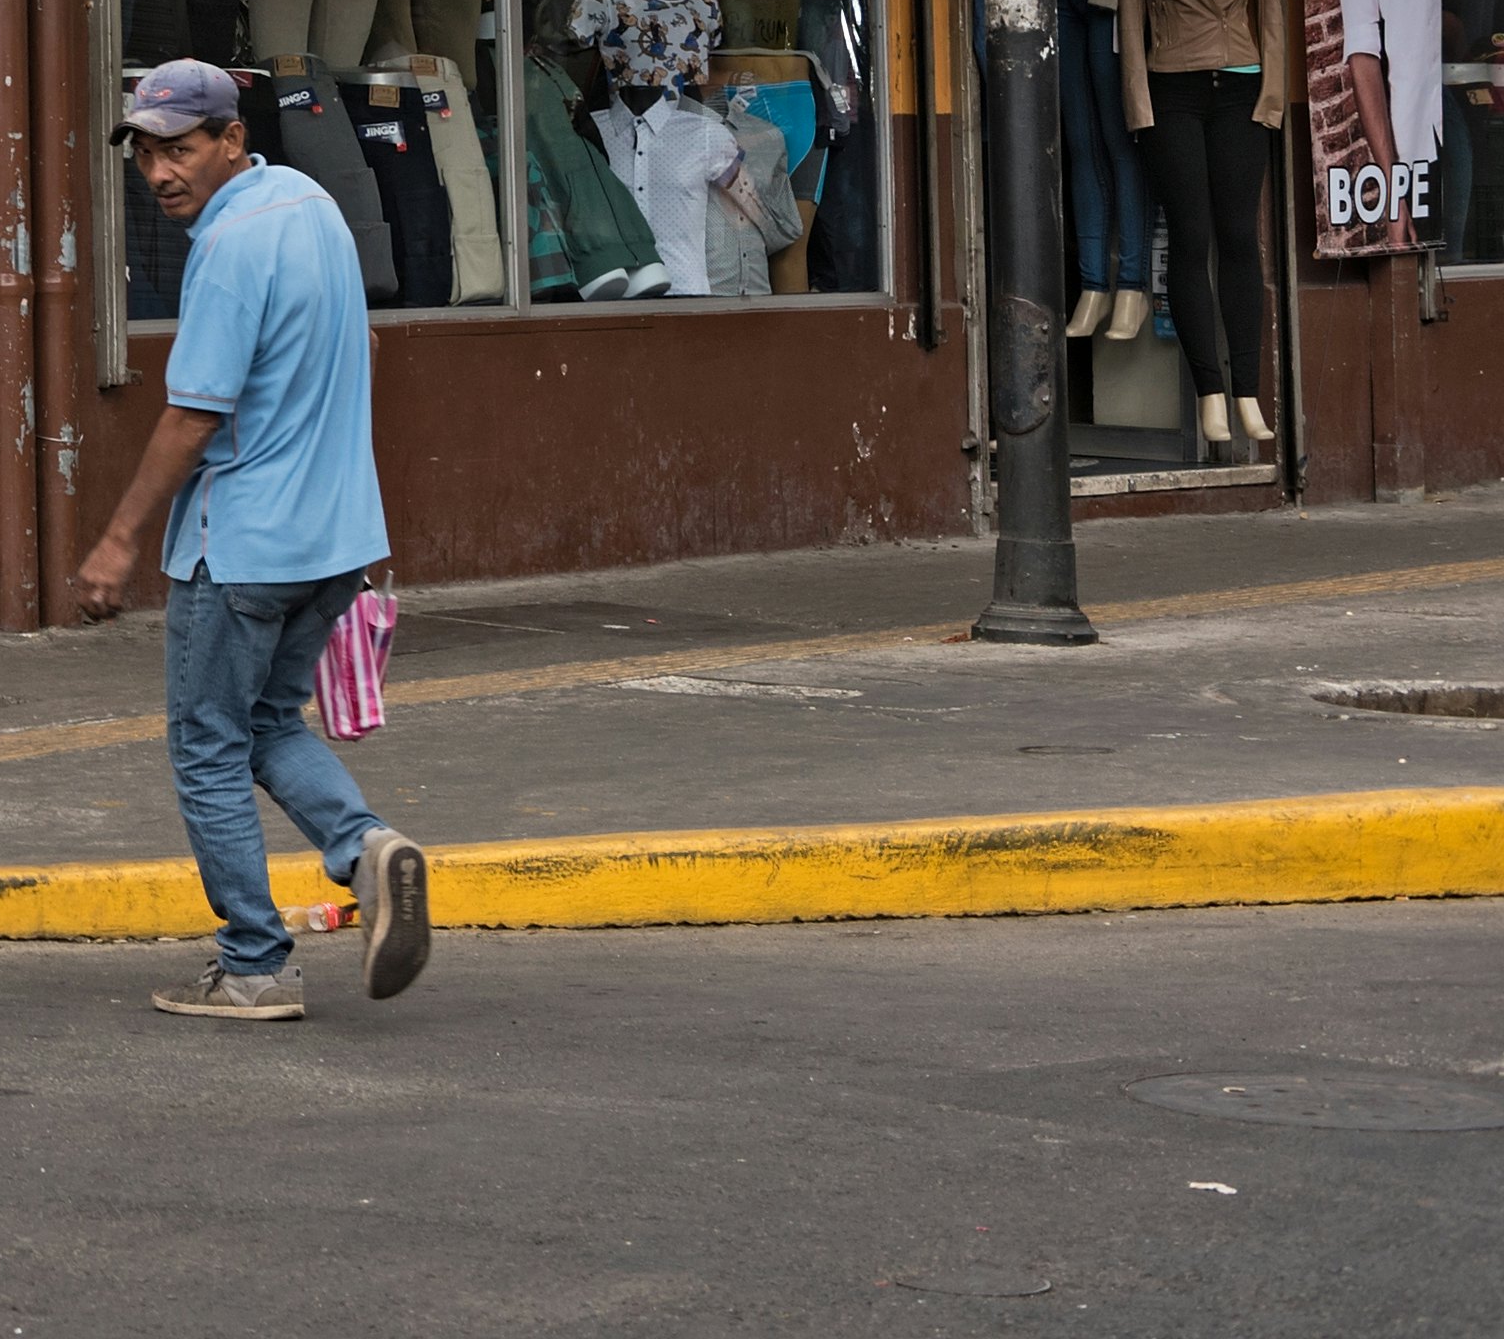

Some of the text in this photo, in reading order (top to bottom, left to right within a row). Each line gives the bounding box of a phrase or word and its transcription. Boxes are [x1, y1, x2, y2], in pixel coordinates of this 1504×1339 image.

[279, 91, 310, 108] JINGO
[365, 125, 399, 138] JINGO
[1329, 161, 1430, 224] BOPE
